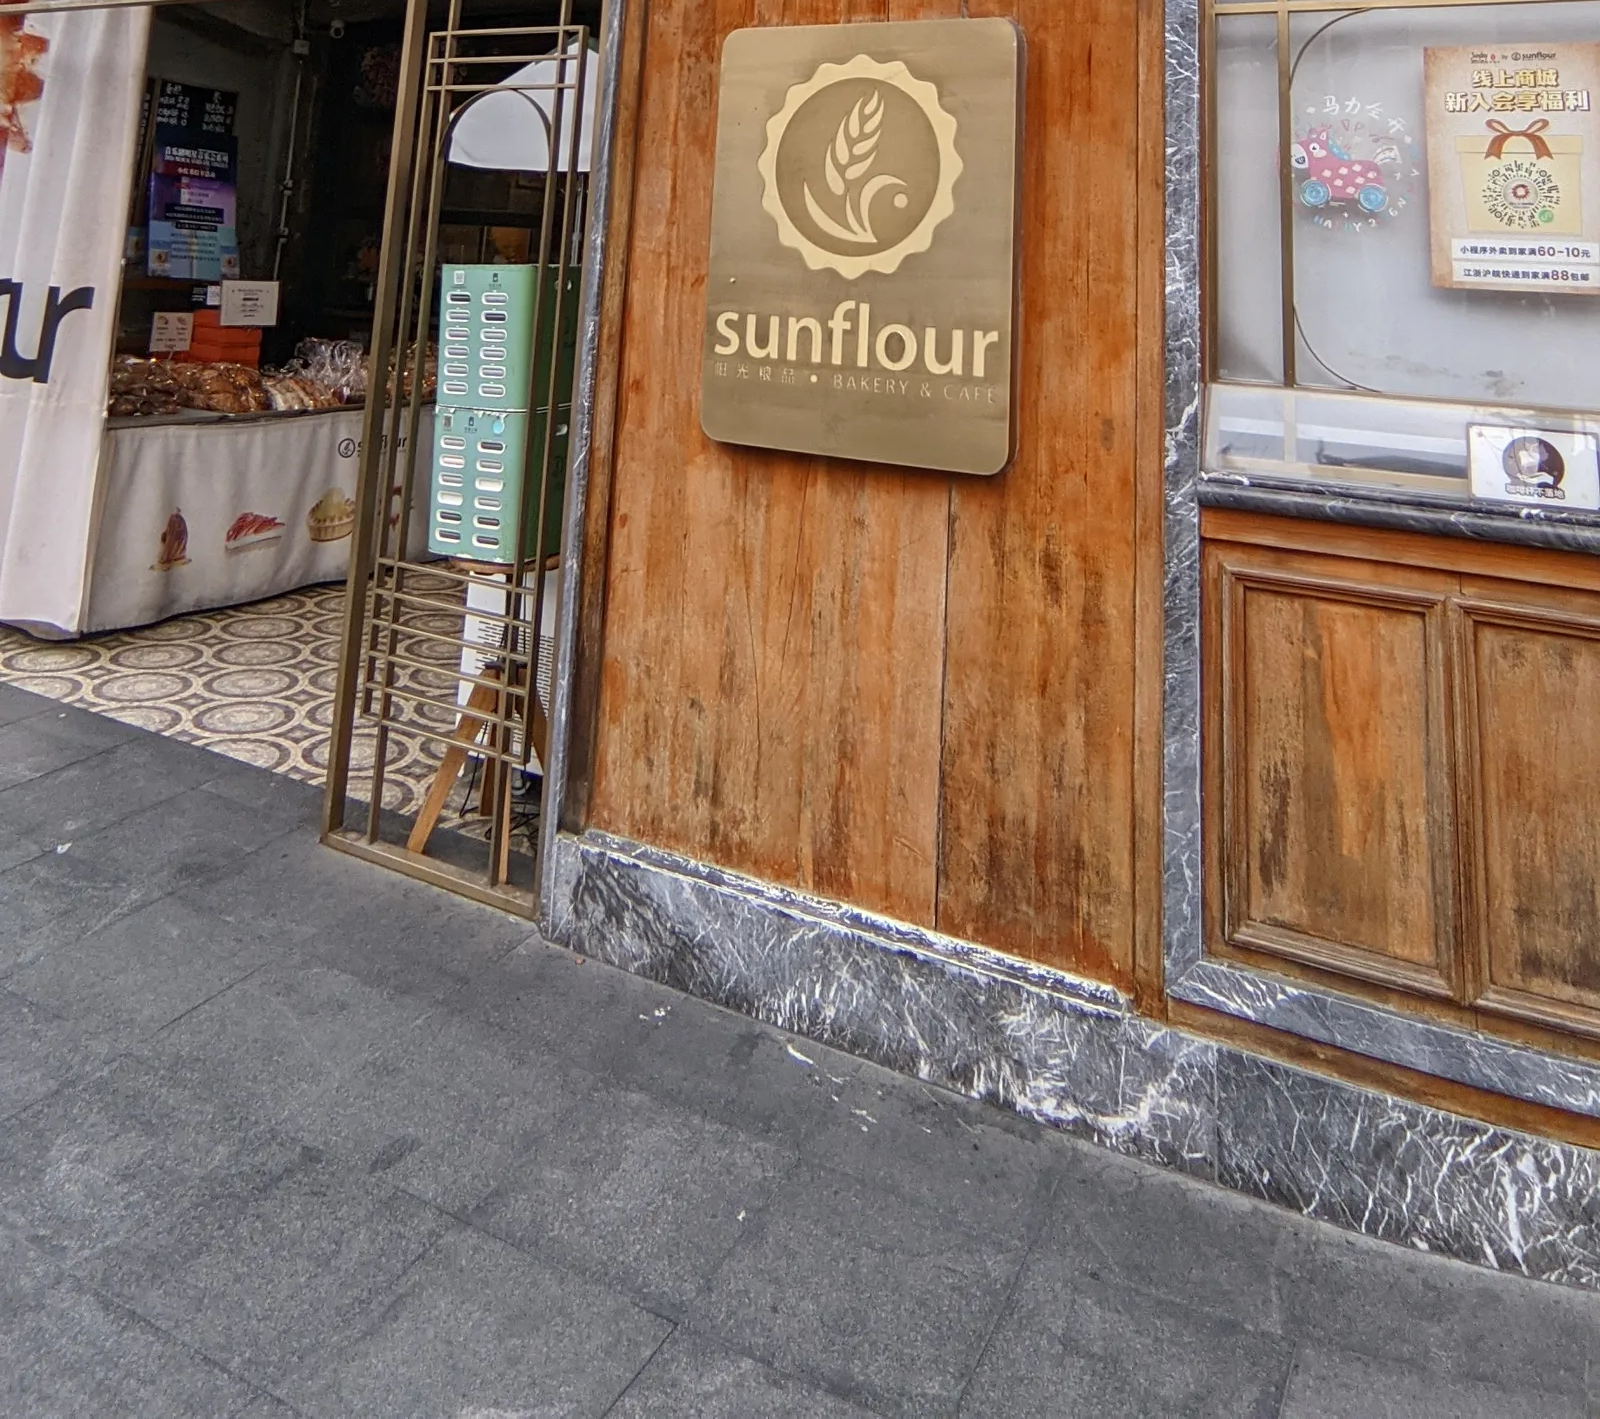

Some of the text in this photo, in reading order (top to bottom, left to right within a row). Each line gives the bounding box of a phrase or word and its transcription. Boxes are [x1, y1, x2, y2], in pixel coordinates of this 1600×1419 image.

[1522, 51, 1556, 60] sunflour
[1471, 68, 1559, 88] 线上商城
[1444, 90, 1590, 112] 新入会享福利
[1460, 245, 1591, 259] 小程序外卖到家满60-10元
[714, 300, 999, 377] sunflour
[832, 373, 909, 396] BAKERY
[920, 382, 932, 398] &
